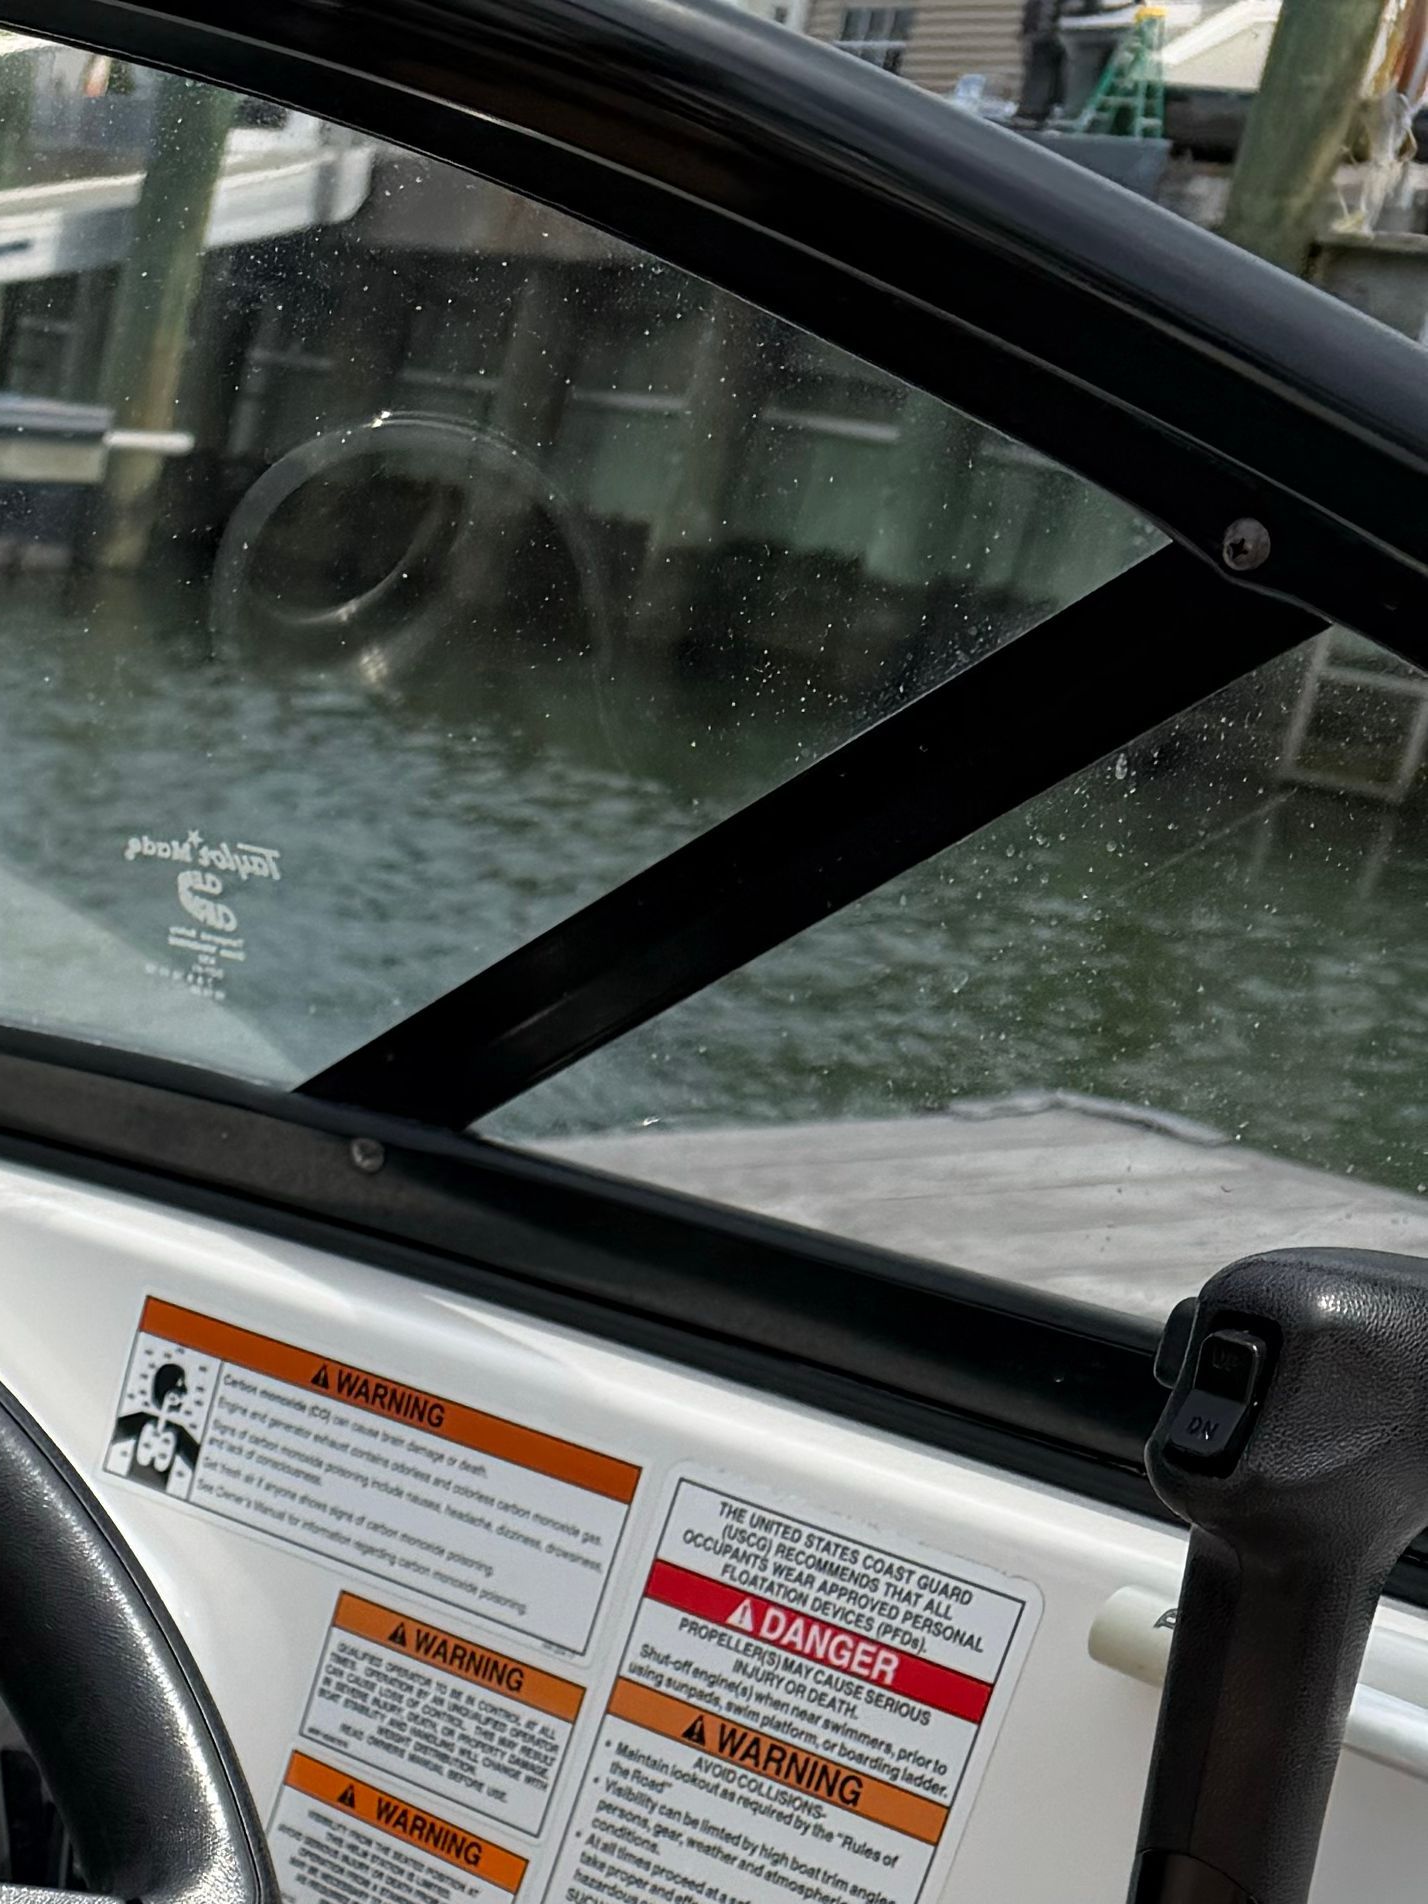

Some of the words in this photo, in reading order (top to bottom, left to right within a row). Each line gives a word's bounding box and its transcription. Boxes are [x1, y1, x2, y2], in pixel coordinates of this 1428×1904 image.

[336, 1368, 445, 1428] WARNING
[682, 1528, 769, 1572] OCCUPANTS
[772, 1561, 816, 1589] WEAR
[816, 1579, 899, 1620] APPROVED
[900, 1609, 983, 1653] PERSONAL
[719, 1501, 747, 1524] THE
[748, 1512, 802, 1543] UNITED
[803, 1532, 860, 1565] STATES
[861, 1553, 916, 1584] COAST
[916, 1574, 973, 1605] GUARD
[721, 1523, 772, 1558] (USCG)
[774, 1542, 880, 1593] RECOMMENDS
[883, 1581, 922, 1607] THAT
[922, 1597, 952, 1620] ALL
[720, 1562, 809, 1607] FLOATATION
[809, 1596, 874, 1632] DEVICES
[876, 1621, 926, 1654] (PFDs).
[759, 1607, 898, 1684] DANGER
[415, 1628, 524, 1692] WARNING
[678, 1616, 781, 1671] PROPELLER(S)
[780, 1656, 814, 1679] MAY
[812, 1668, 864, 1700] CAUSE
[863, 1688, 931, 1726] SERIOUS
[731, 1658, 785, 1689] INJURY
[784, 1679, 807, 1699] OR
[806, 1687, 858, 1719] DEATH.
[627, 1662, 664, 1688] using
[664, 1676, 722, 1711] sunpads,
[724, 1700, 760, 1722] swim
[759, 1714, 819, 1749] platform,
[821, 1738, 838, 1752] or
[837, 1741, 901, 1781] boarding
[900, 1766, 947, 1798] ladder.
[639, 1643, 694, 1675] Shut-off
[691, 1666, 753, 1702] engine(s)
[754, 1691, 790, 1714] when
[790, 1705, 822, 1725] near
[821, 1718, 895, 1758] swimmers,
[895, 1747, 932, 1769] prior
[932, 1759, 947, 1776] to
[615, 1741, 669, 1775] Maintain
[669, 1764, 720, 1796] lookout
[718, 1787, 736, 1802] as
[736, 1794, 794, 1825] required
[792, 1814, 811, 1836] by
[811, 1822, 834, 1842] the
[882, 1854, 899, 1868] of
[692, 1756, 737, 1783] AVOID
[717, 1722, 863, 1807] WARNING
[376, 1796, 482, 1866] WARNING
[605, 1777, 658, 1814] Visibility
[658, 1804, 682, 1822] can
[682, 1811, 699, 1829] be
[740, 1835, 759, 1856] by
[758, 1842, 789, 1867] high
[789, 1855, 821, 1880] boat
[820, 1869, 848, 1892] trim
